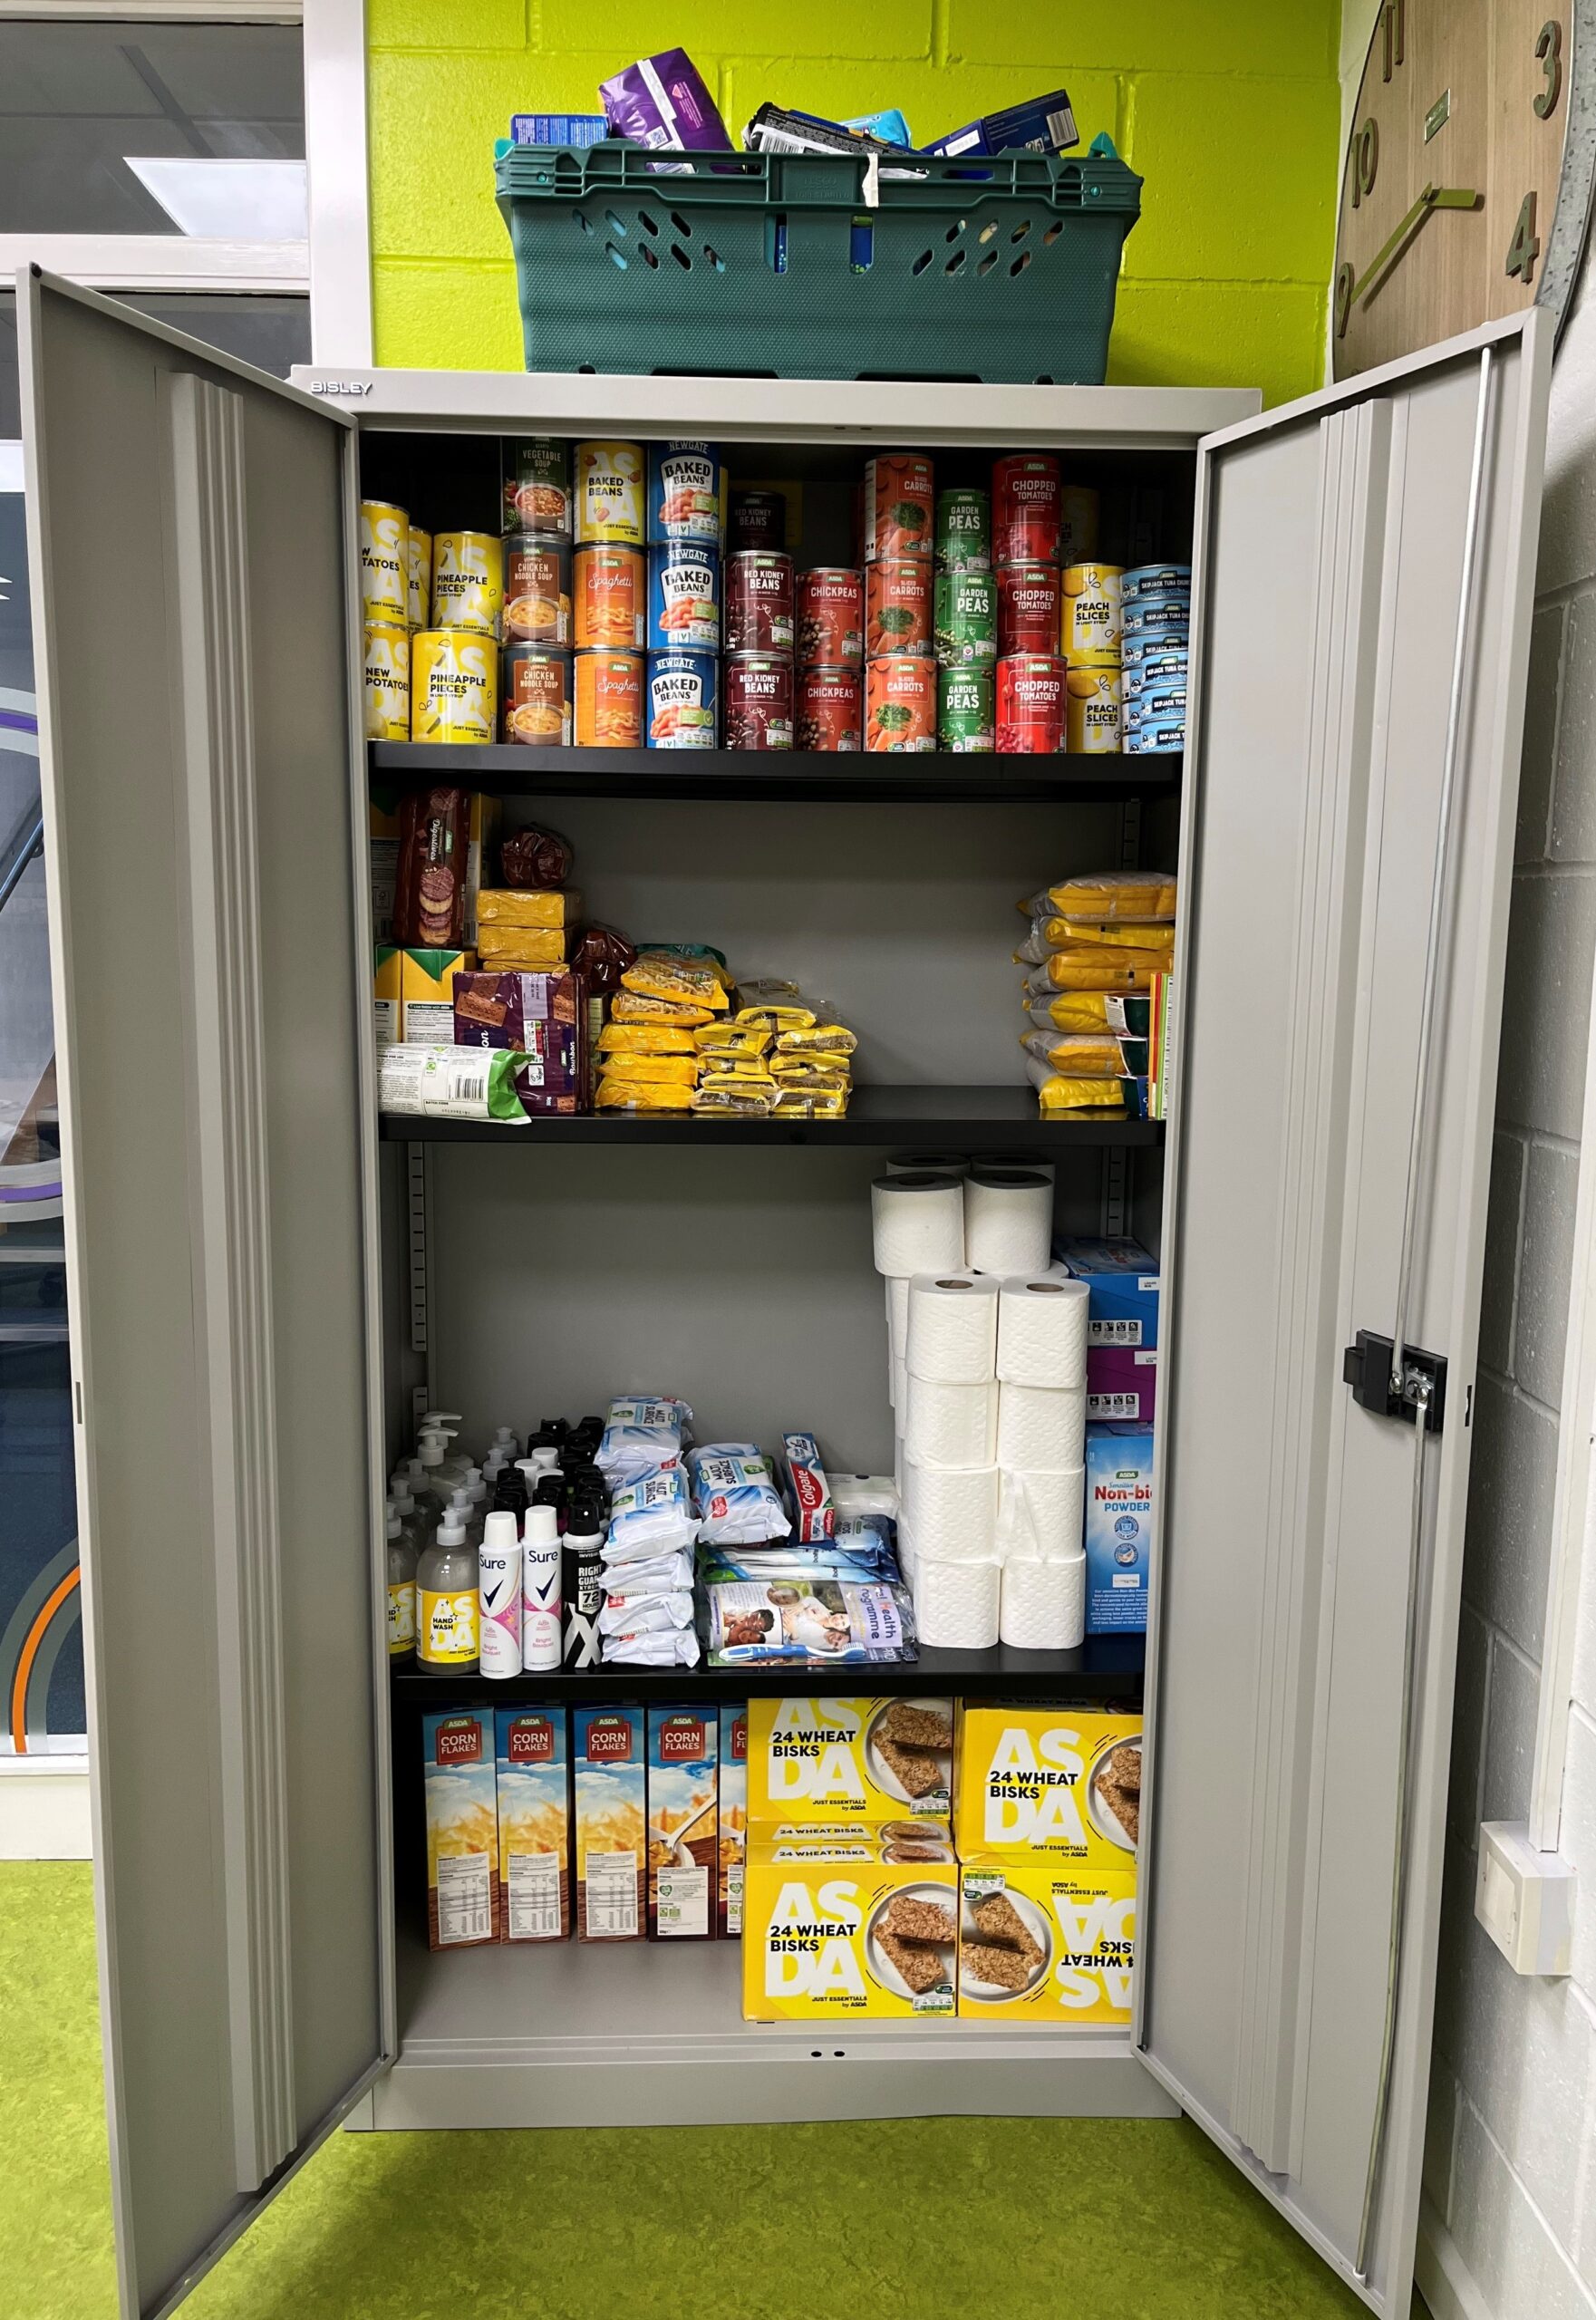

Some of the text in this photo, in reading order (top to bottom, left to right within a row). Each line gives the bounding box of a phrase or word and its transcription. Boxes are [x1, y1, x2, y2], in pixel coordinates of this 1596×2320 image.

[1533, 20, 1562, 121] 3
[1350, 117, 1379, 209] 10
[1505, 190, 1540, 285] 4
[1336, 262, 1354, 338] 9
[311, 382, 372, 394] BISLEY
[523, 450, 561, 462] VEGETABLE
[664, 462, 711, 478] BAKED
[589, 478, 624, 486] BAKED
[674, 476, 704, 485] BEANS
[1013, 480, 1055, 491] CHOPPED
[589, 488, 623, 497] BEANS
[904, 481, 932, 495] CARROTS
[1018, 491, 1052, 500] TOMATOES
[952, 507, 979, 515] GARDEN
[949, 516, 980, 529] PEAS
[669, 549, 709, 563] NEWGATE
[363, 557, 400, 571] TATOES
[518, 563, 548, 573] CHICKEN
[437, 575, 488, 585] PINEAPPLE
[665, 571, 711, 586] BAKED
[744, 570, 784, 580] RED KIDNEY
[589, 573, 632, 590] Spaghetti
[750, 579, 779, 590] BEANS
[437, 585, 465, 593] PIECES
[674, 584, 704, 593] BEANS
[811, 587, 857, 598] CHICKPEAS
[890, 586, 924, 596] CARROTS
[961, 588, 987, 597] GARDEN
[1012, 590, 1054, 602] CHOPPED
[957, 598, 989, 613] PEAS
[1017, 602, 1051, 610] TOMATOES
[1077, 603, 1109, 611] PEACH
[1076, 612, 1109, 621] SLICES
[655, 658, 695, 670] NEWGATE
[366, 668, 390, 677] NEW
[524, 671, 554, 681] CHICKEN
[755, 674, 779, 682] KIDNEY
[430, 674, 486, 687] PINEAPPLE
[597, 676, 639, 694] Spaghetti
[1015, 681, 1059, 691] CHOPPED
[430, 685, 467, 693] PIECES
[653, 679, 698, 695] BAKED
[745, 683, 775, 693] BEANS
[887, 682, 924, 692] CARROTS
[949, 685, 977, 694] GARDEN
[661, 691, 691, 701] BEANS
[808, 688, 854, 699] CHICKPEAS
[1020, 692, 1056, 701] TOMATOES
[947, 694, 979, 709] PEAS
[430, 818, 440, 861] Digestives
[798, 1470, 815, 1505] Colgate
[1095, 1484, 1152, 1500] Non-bi
[1105, 1503, 1149, 1512] POWDER
[529, 1551, 558, 1562] Sure
[479, 1555, 506, 1570] Sure
[578, 1566, 602, 1576] RIGHT
[583, 1591, 598, 1603] 72
[860, 1589, 879, 1639] rogramme
[878, 1602, 896, 1638] Health
[440, 1734, 477, 1746] CORN
[513, 1733, 548, 1744] CORN
[591, 1732, 626, 1743] CORN
[665, 1732, 700, 1743] CORN
[773, 1731, 856, 1743] 24 WHEAT
[441, 1745, 477, 1754] FLAKES
[513, 1743, 548, 1752] FLAKES
[592, 1742, 626, 1751] FLAKES
[665, 1742, 700, 1751] FLAKES
[773, 1745, 819, 1757] BISKS
[990, 1771, 1078, 1785] 24 WHEAT
[990, 1786, 1040, 1799] BISKS
[770, 1924, 856, 1938] 24 WHEAT
[770, 1940, 819, 1951] BISKS
[1061, 1955, 1123, 1967] WHEAT
